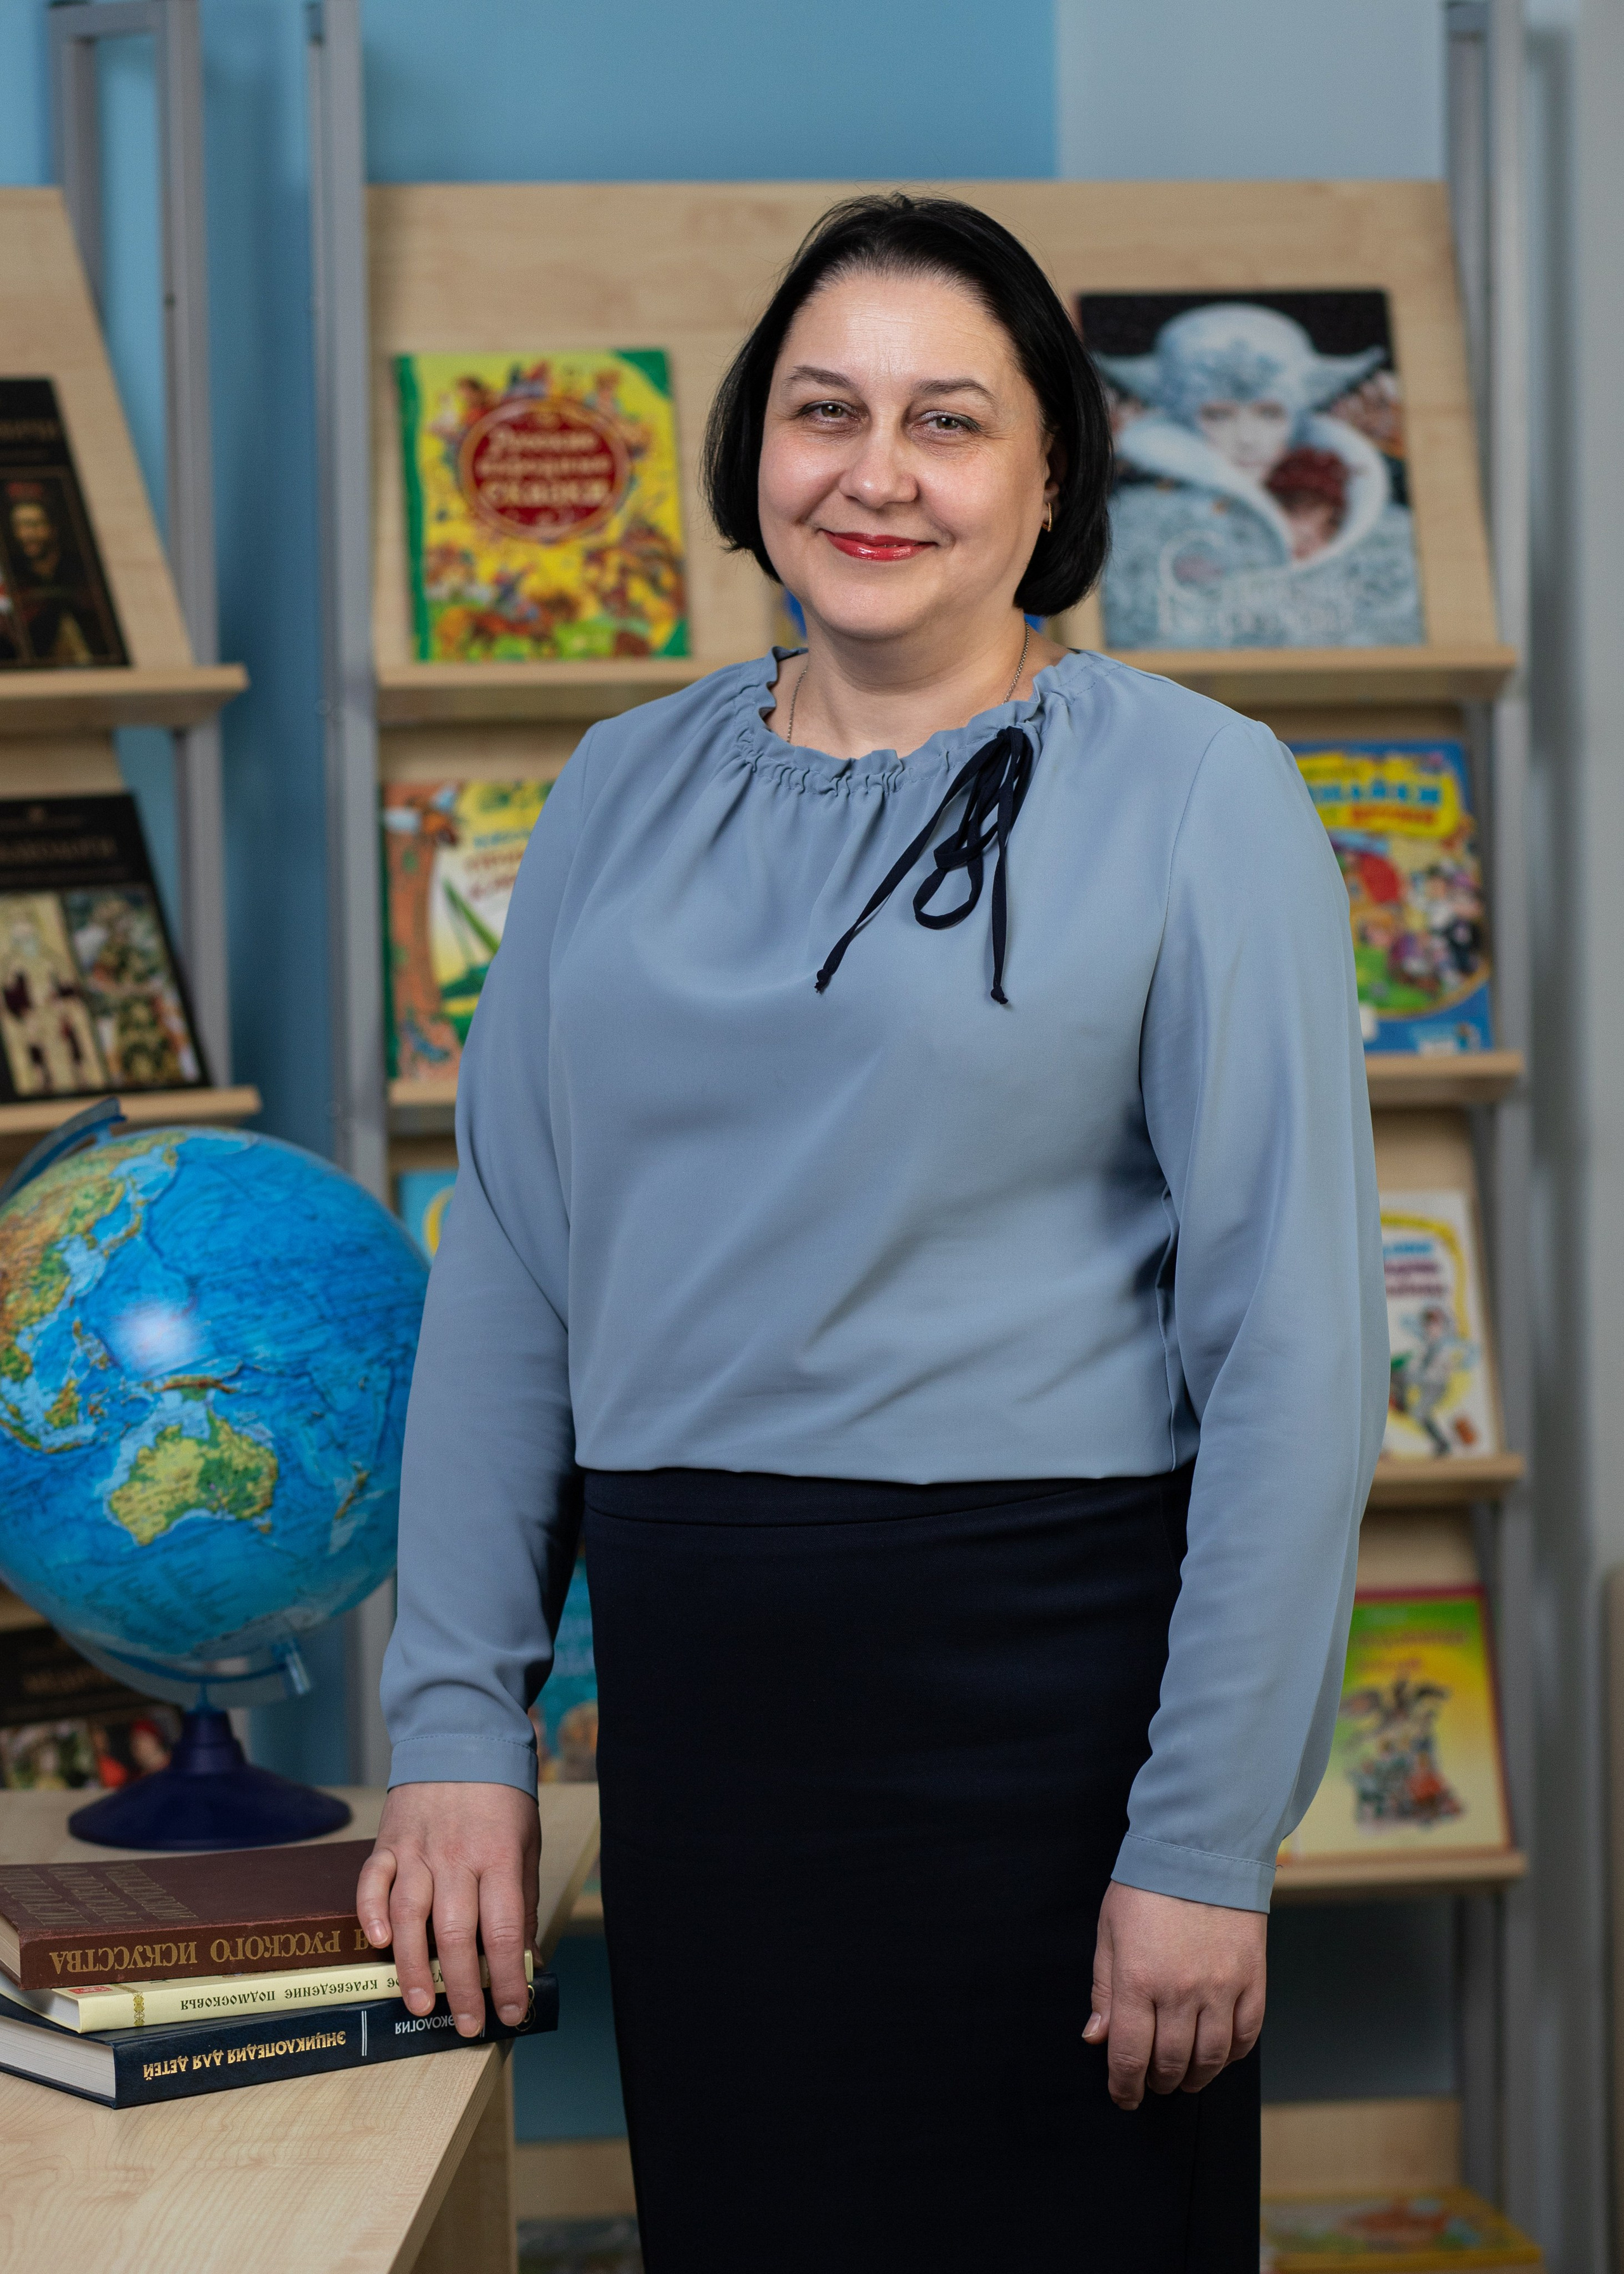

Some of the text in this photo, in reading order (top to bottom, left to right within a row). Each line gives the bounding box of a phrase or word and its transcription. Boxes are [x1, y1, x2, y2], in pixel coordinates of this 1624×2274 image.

[49, 1942, 197, 1975] ИСКУССТВА
[209, 1930, 341, 1963] РУССКОГО
[180, 1991, 275, 2011] ПОДМОСКОВЬЯ
[284, 1979, 379, 1999] КРАЕВЕДЕНИЕ
[395, 2015, 455, 2035] ЭКОЛОГИЯ
[143, 2030, 346, 2081] ЭНЦИКЛОПЕДИЯ ДЛЯ ДЕТЕЙ
